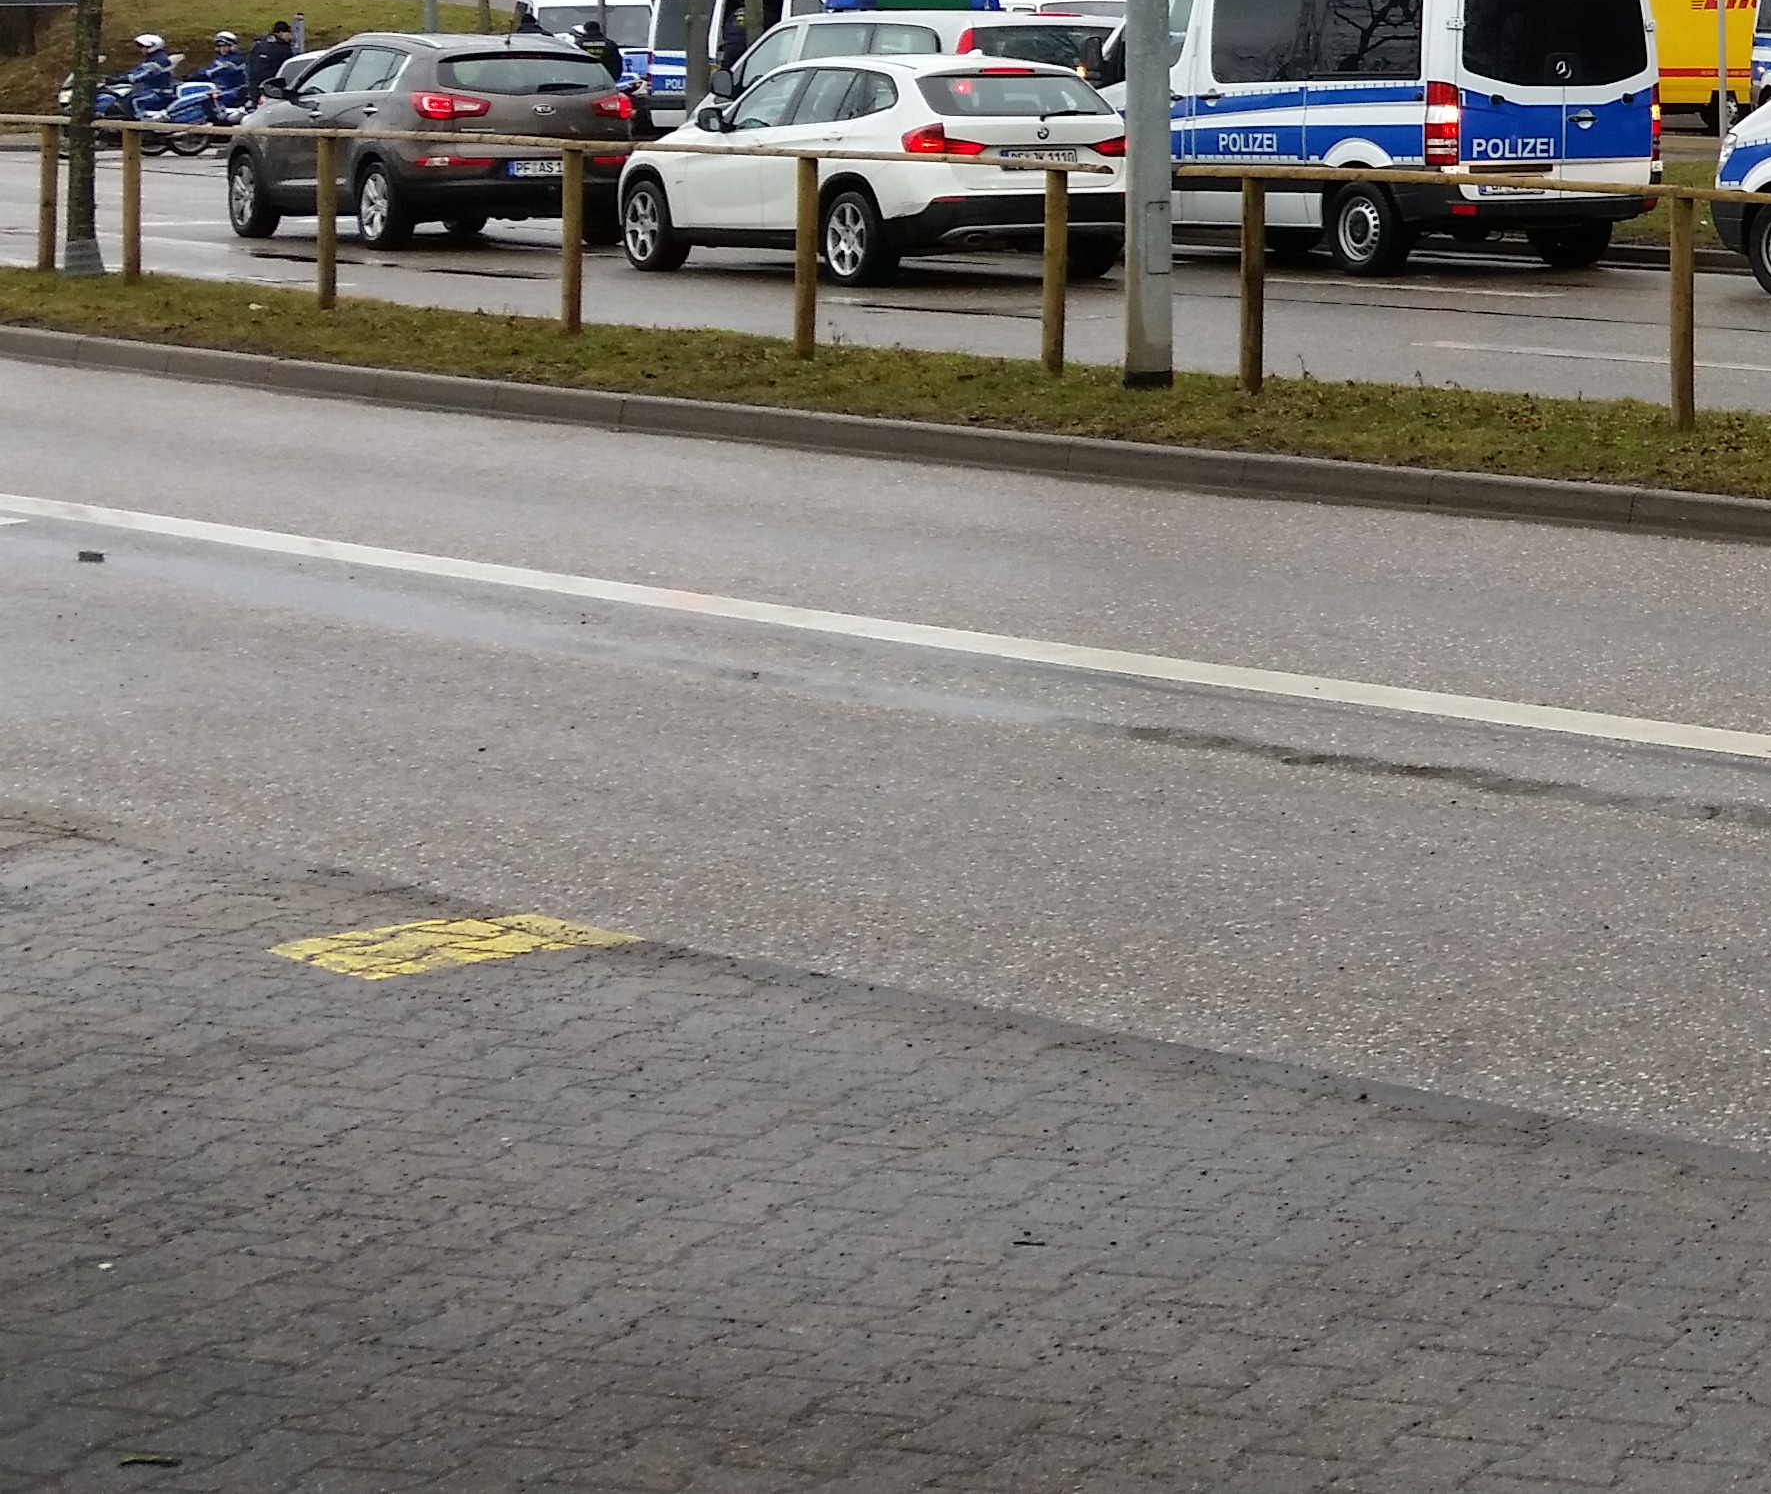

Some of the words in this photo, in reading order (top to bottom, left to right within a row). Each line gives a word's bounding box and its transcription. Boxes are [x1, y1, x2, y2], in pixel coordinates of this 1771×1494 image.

[665, 78, 687, 89] POLI
[1218, 132, 1278, 153] POLIZEI
[1472, 137, 1555, 158] POLIZEI
